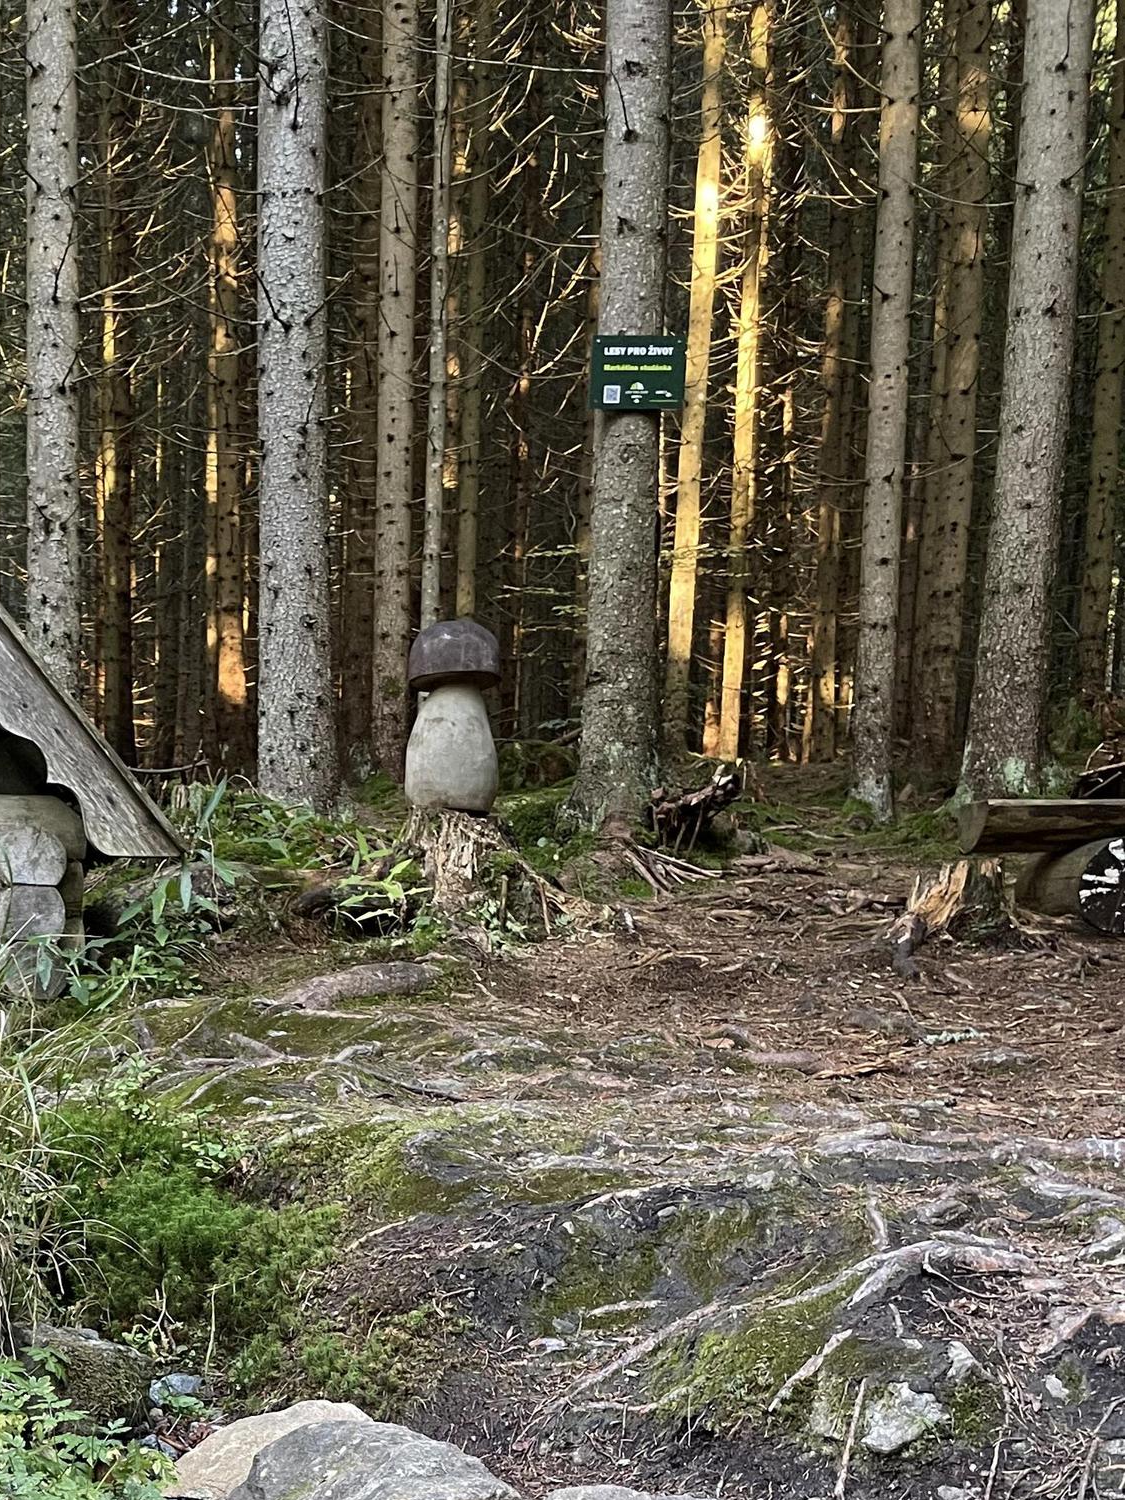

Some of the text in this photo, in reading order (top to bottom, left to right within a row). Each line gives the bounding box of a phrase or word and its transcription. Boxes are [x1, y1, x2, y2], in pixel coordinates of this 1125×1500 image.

[604, 345, 673, 356] LESY PRO ŽIVOT
